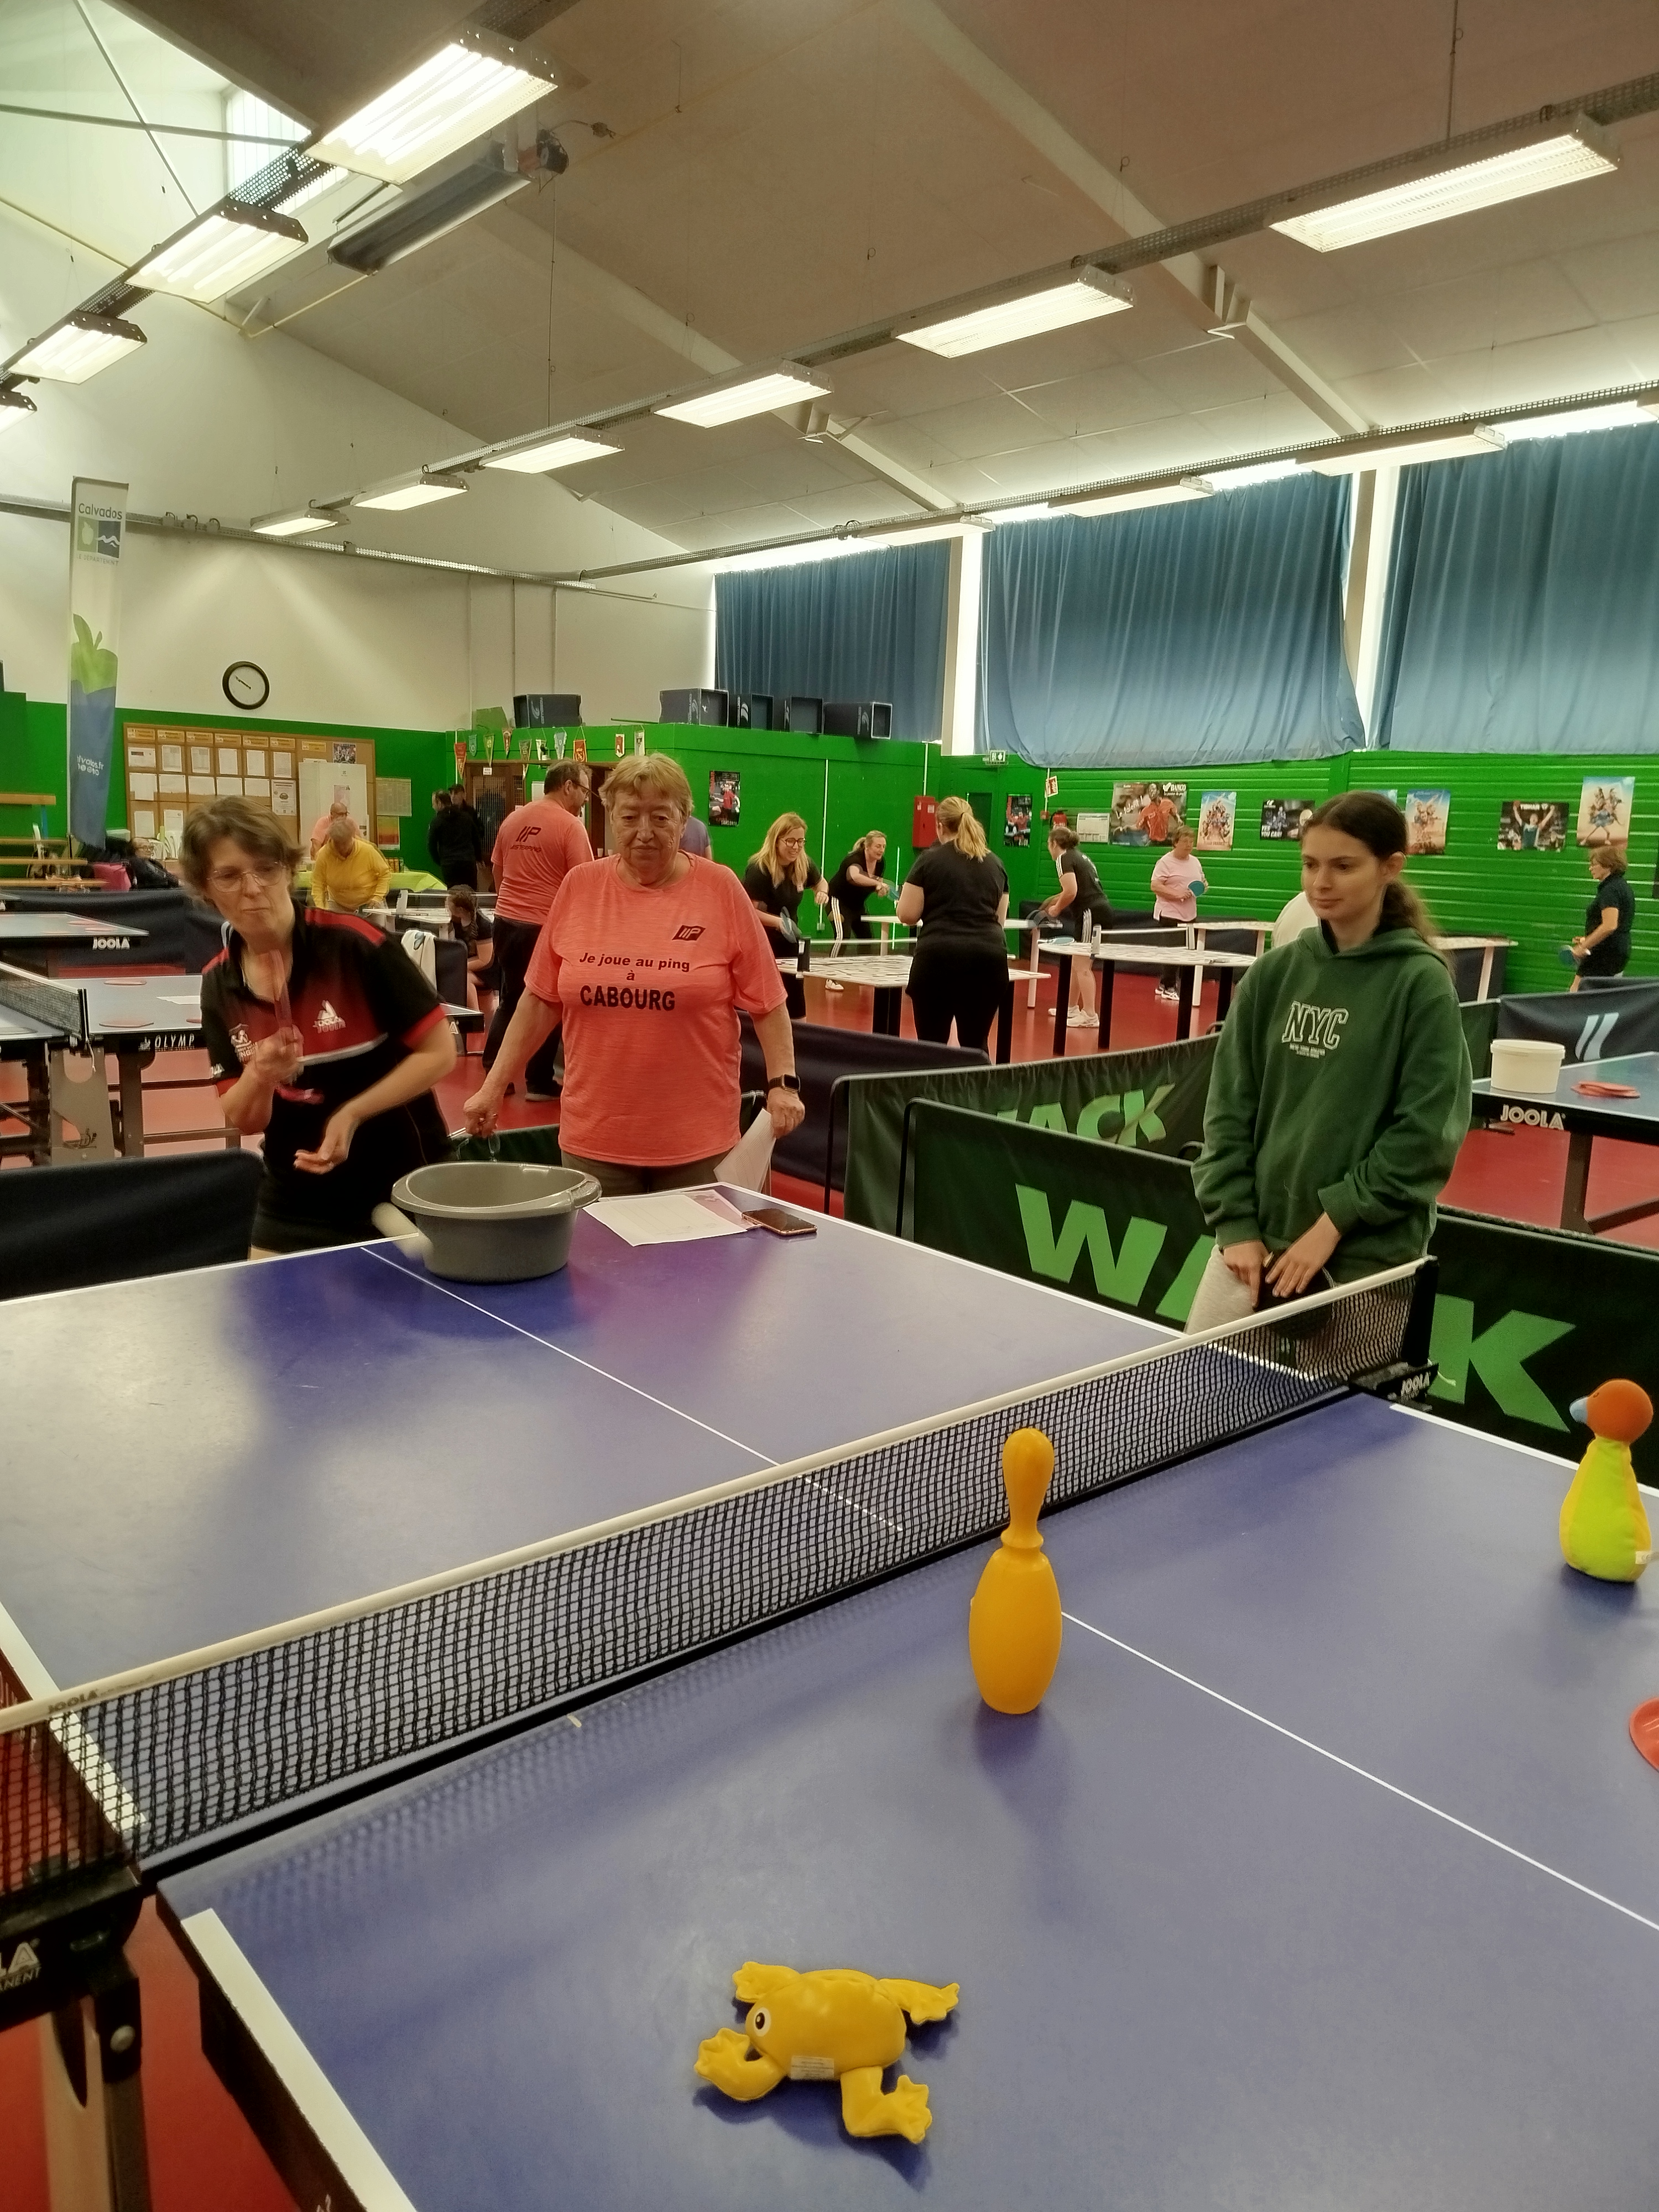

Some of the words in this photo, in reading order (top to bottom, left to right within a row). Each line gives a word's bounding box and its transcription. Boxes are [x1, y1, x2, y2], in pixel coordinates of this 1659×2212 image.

[79, 503, 122, 520] Calvados
[1115, 811, 1123, 819] Le
[92, 937, 130, 951] JOOLA
[580, 953, 596, 963] Je
[597, 954, 630, 966] joue
[635, 959, 654, 967] au
[658, 959, 690, 972] ping
[626, 970, 635, 981] à
[580, 985, 675, 1011] CABOURG
[1282, 1000, 1349, 1050] NYC
[155, 1033, 195, 1048] OLYMP
[997, 1082, 1176, 1147] ACK
[1500, 1104, 1564, 1130] JOOLA
[1401, 1371, 1430, 1396] JOOLA
[48, 1690, 97, 1714] JOOLA
